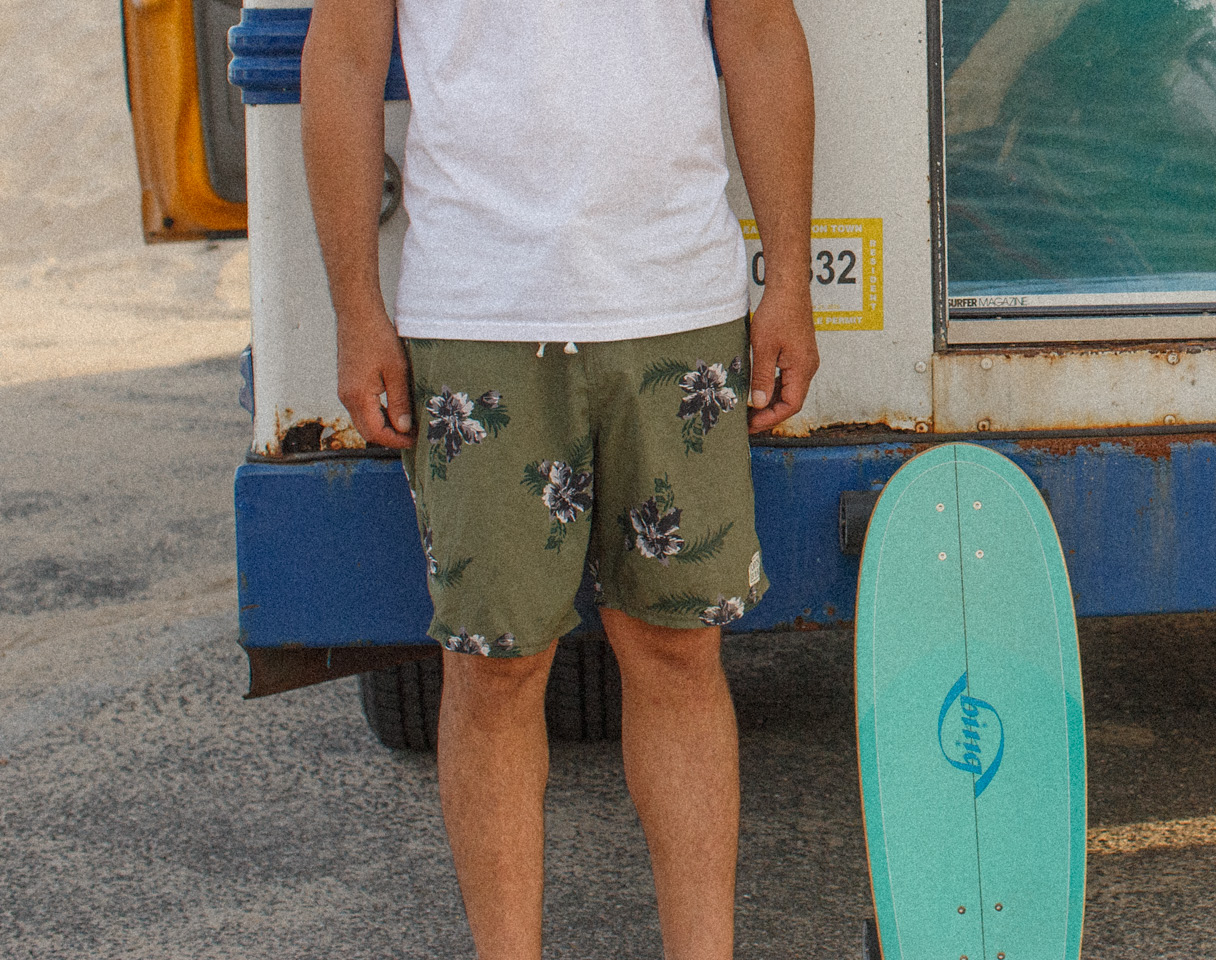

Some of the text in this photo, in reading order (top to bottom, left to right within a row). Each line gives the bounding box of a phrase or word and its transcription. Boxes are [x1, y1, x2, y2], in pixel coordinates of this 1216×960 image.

[831, 224, 863, 234] TOWN
[752, 250, 856, 286] 032
[869, 239, 877, 311] RESIDENT
[948, 296, 1027, 308] SURFER MAGAZINE
[826, 316, 862, 326] PERMIT
[947, 693, 997, 777] bing
